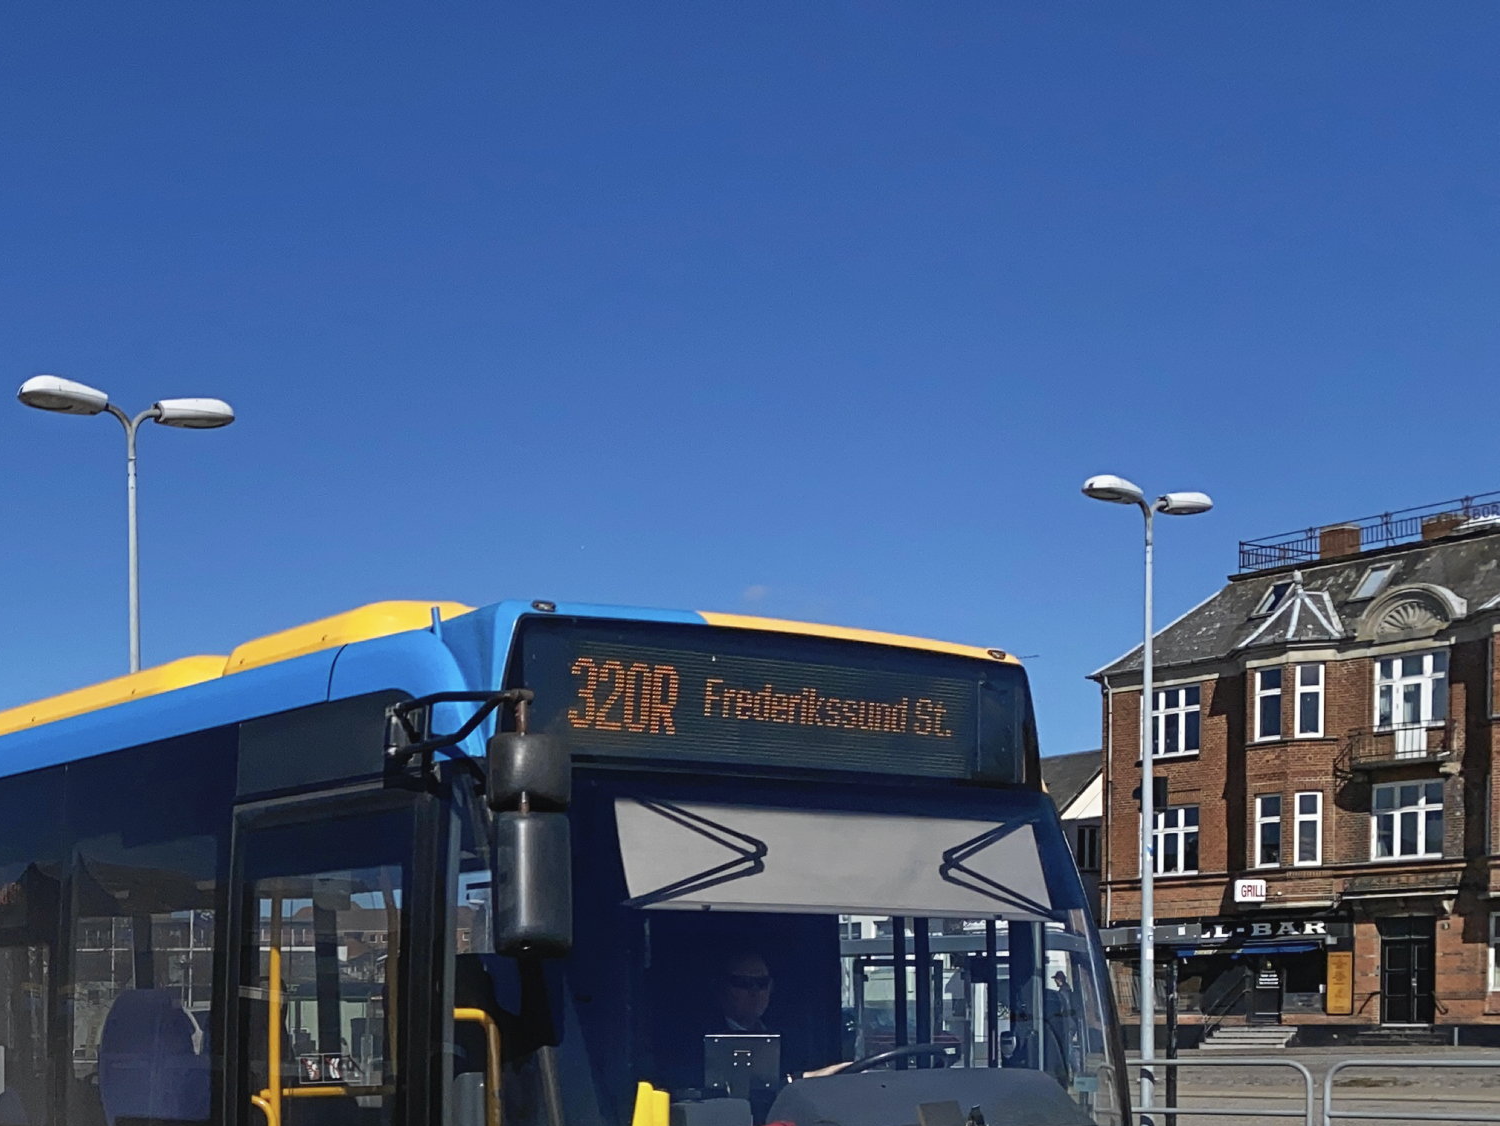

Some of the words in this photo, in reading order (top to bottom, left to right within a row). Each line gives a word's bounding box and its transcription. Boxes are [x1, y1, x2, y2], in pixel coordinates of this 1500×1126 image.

[568, 657, 679, 735] 320R
[704, 678, 908, 733] Frederikssund
[914, 698, 951, 737] St.
[1241, 884, 1265, 898] GRILL
